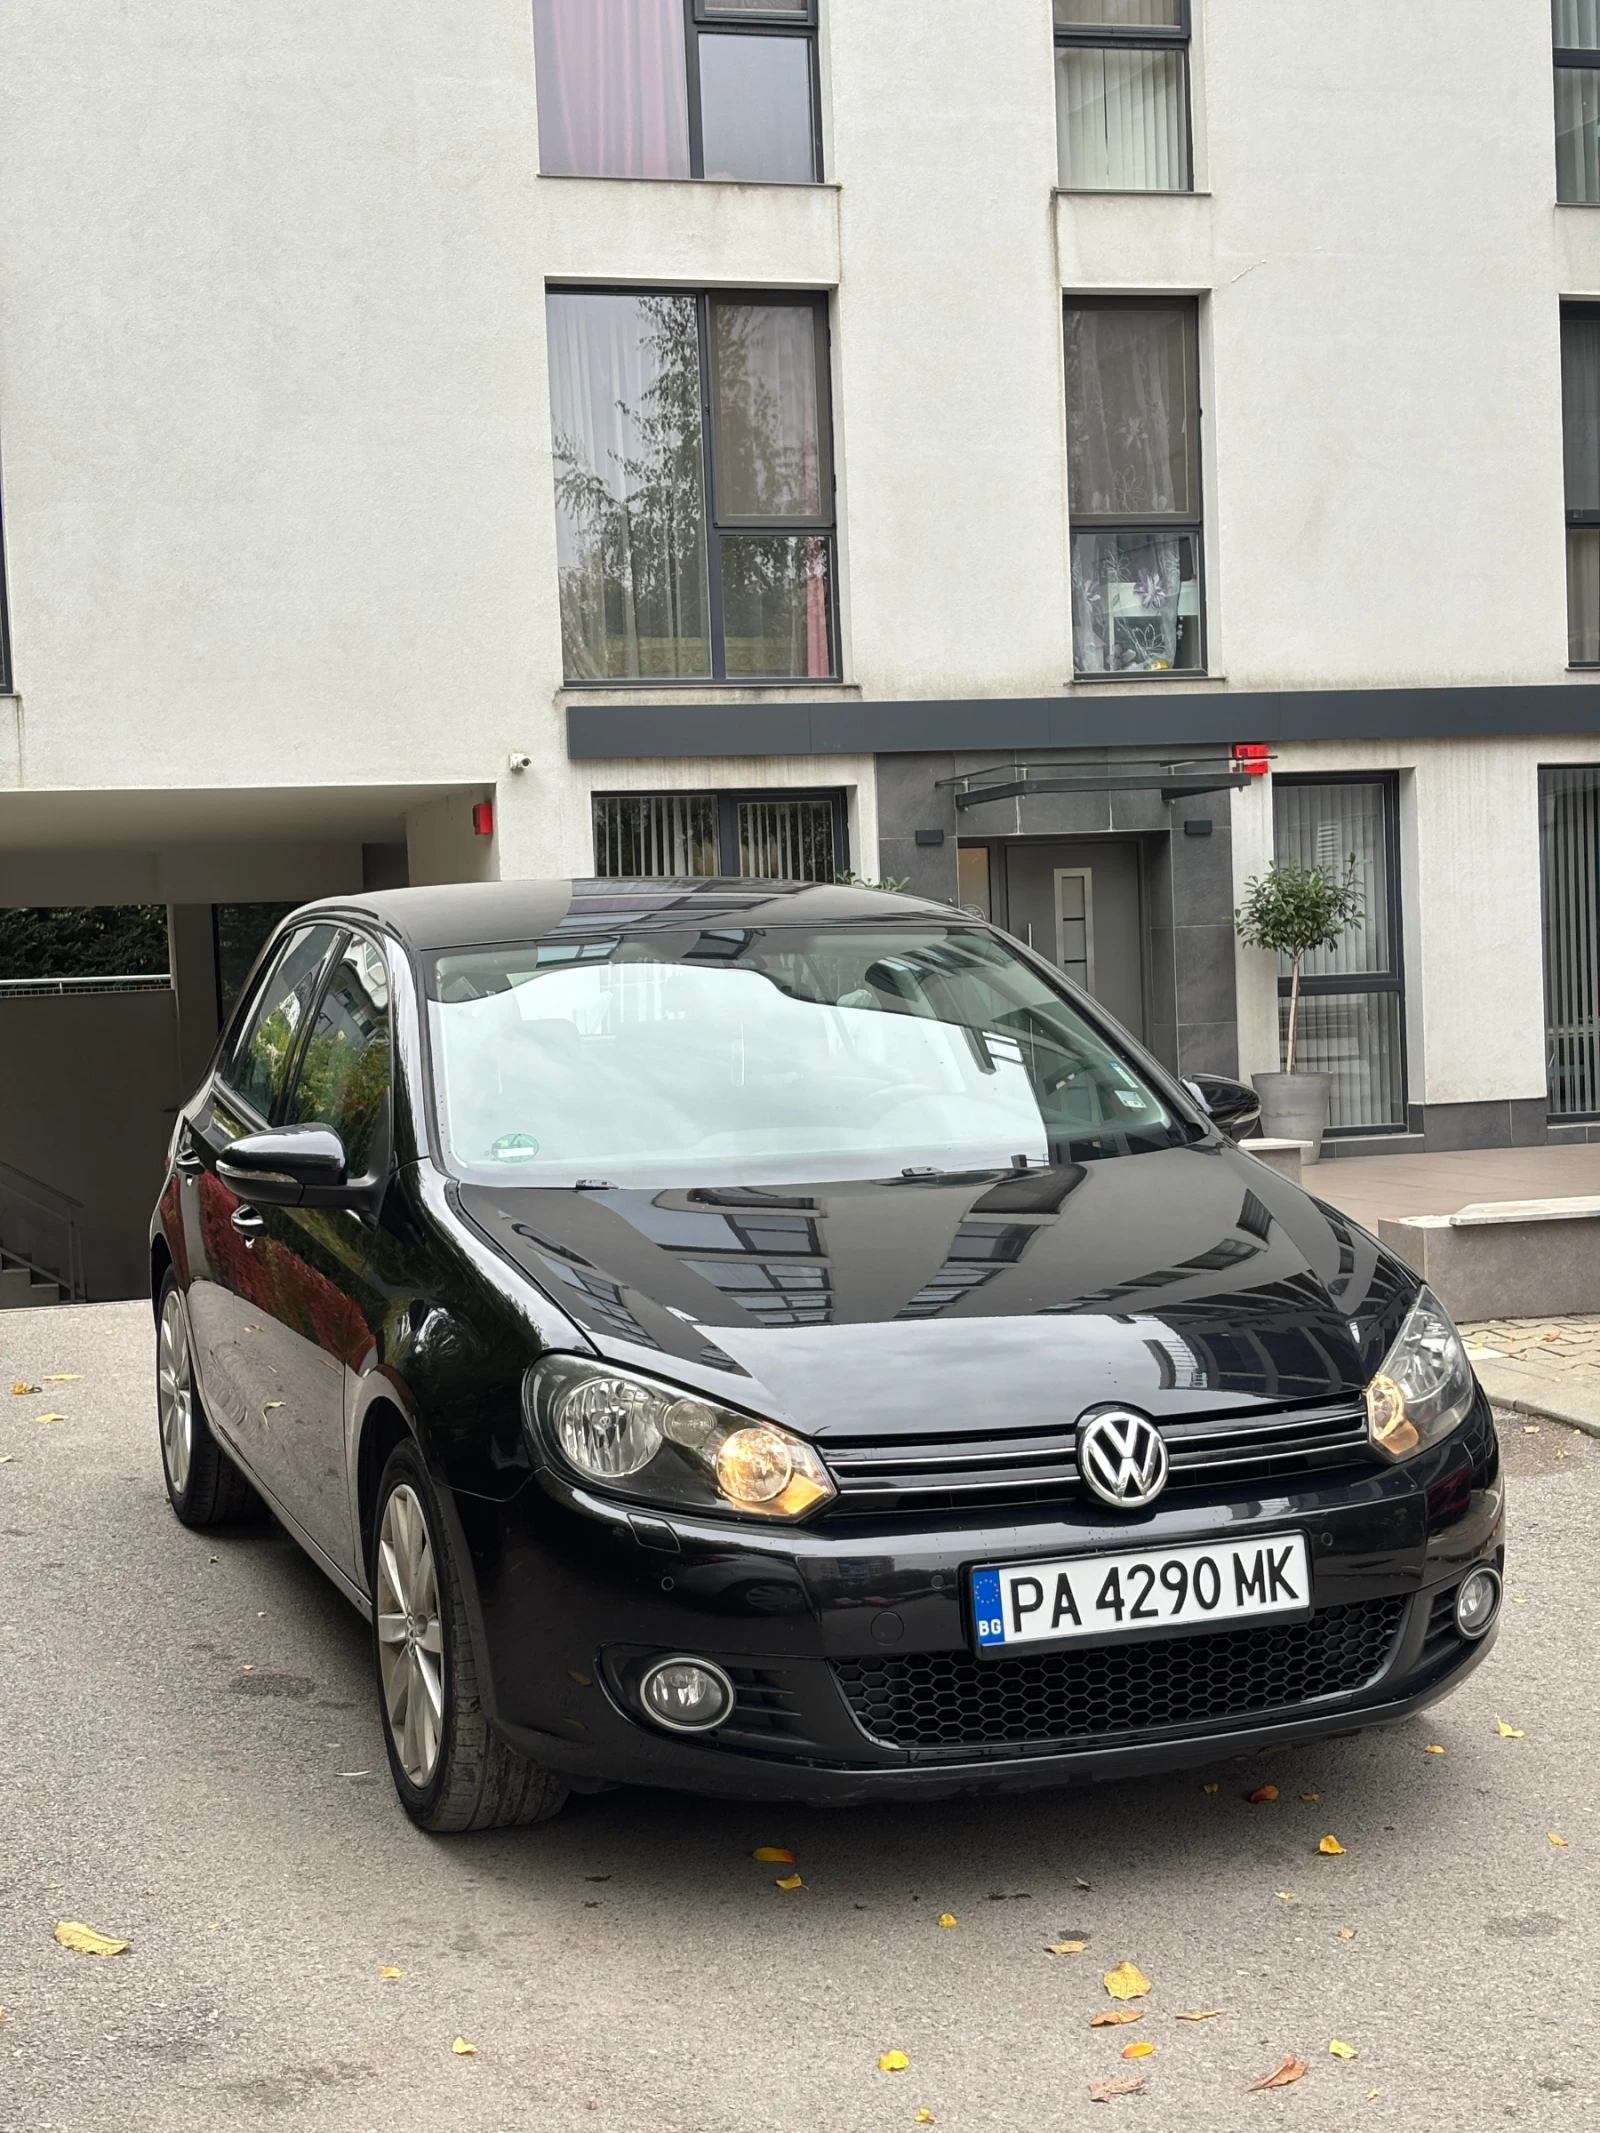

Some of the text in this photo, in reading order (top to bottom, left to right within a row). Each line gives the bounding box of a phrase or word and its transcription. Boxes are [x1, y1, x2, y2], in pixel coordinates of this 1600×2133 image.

[1084, 1414, 1163, 1502] VW
[978, 1619, 1002, 1636] BG
[1009, 1545, 1300, 1634] PA 4290 MK
